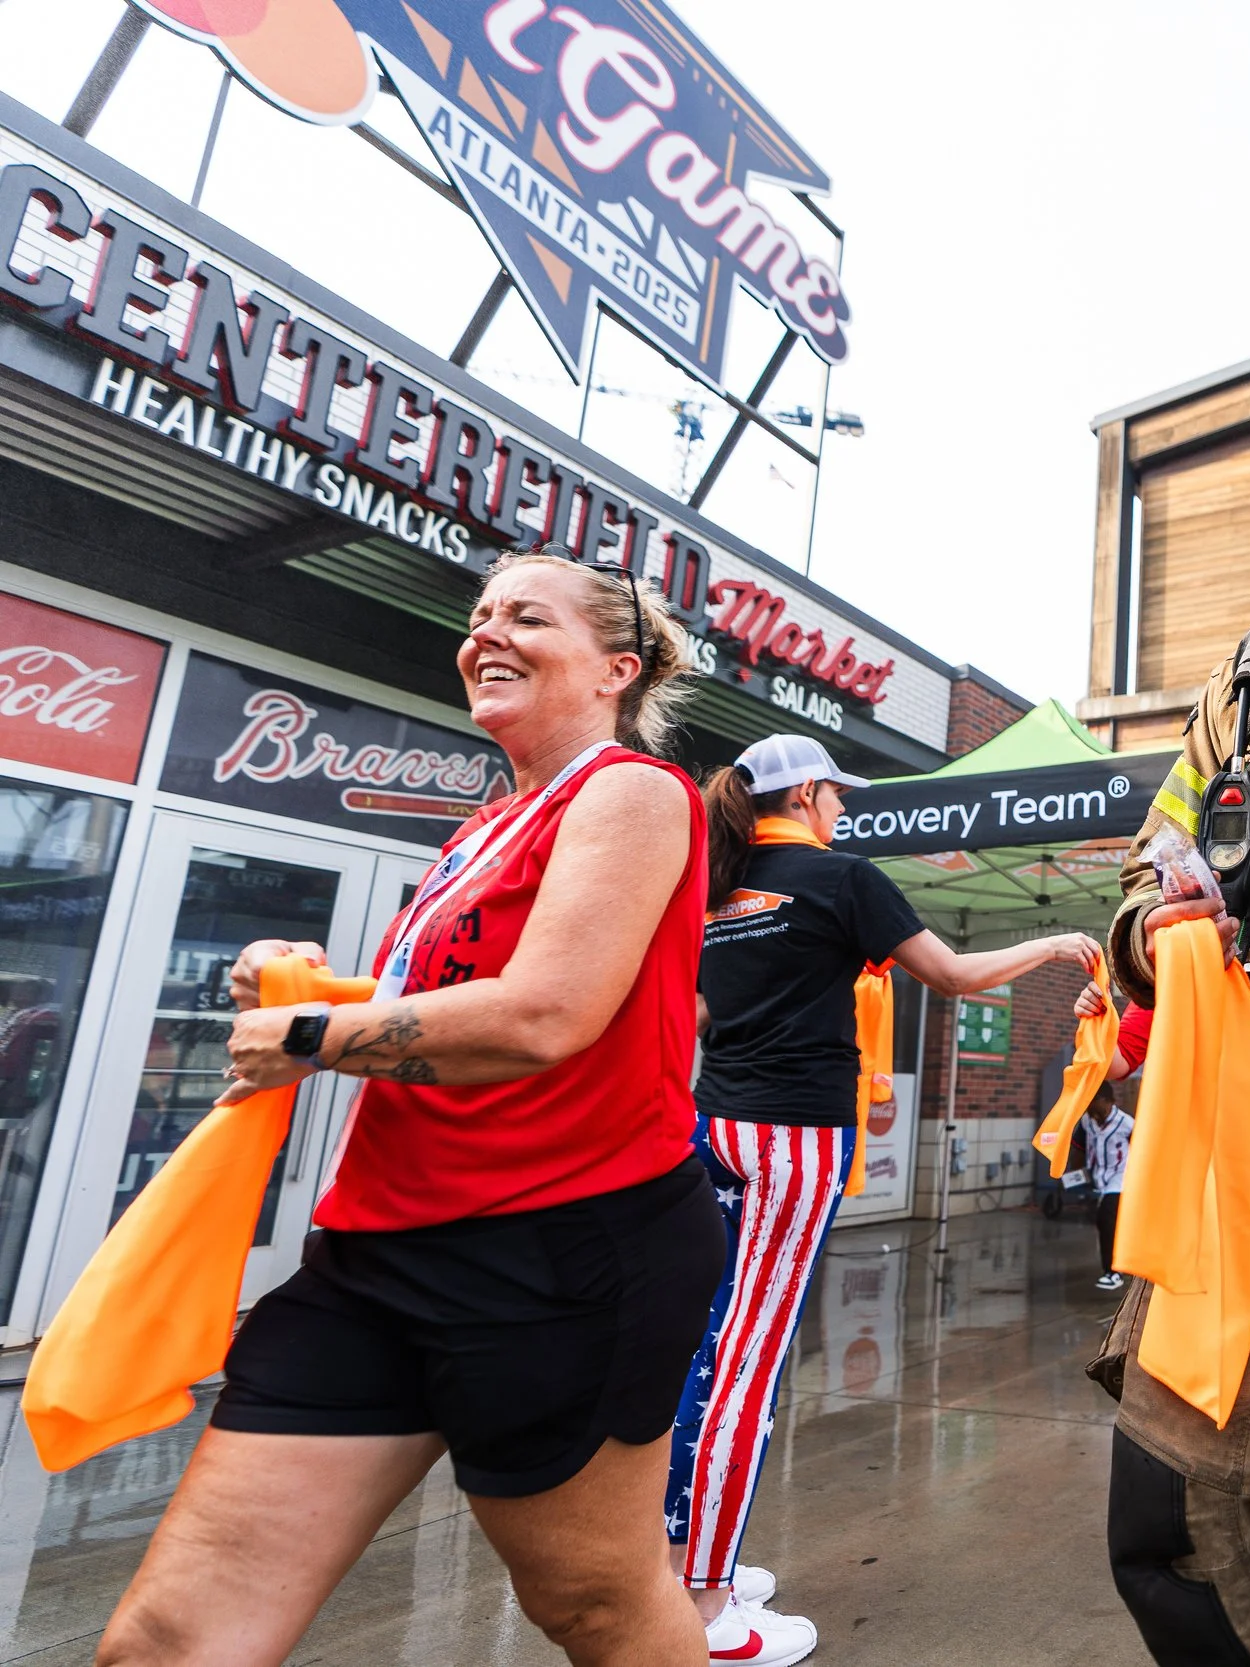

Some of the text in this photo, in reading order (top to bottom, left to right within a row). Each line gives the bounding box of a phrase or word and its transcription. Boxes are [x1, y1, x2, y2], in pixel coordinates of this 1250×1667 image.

[428, 105, 691, 329] ATLANTA 2025
[0, 164, 711, 627] CENTERFIELD
[90, 357, 310, 492] HEALTHY
[314, 462, 472, 565] SNACKS
[770, 674, 844, 733] SALADS
[708, 578, 896, 705] Market
[213, 689, 489, 796] Braves
[831, 801, 982, 841] ecovery
[717, 895, 766, 917] ERVPRO
